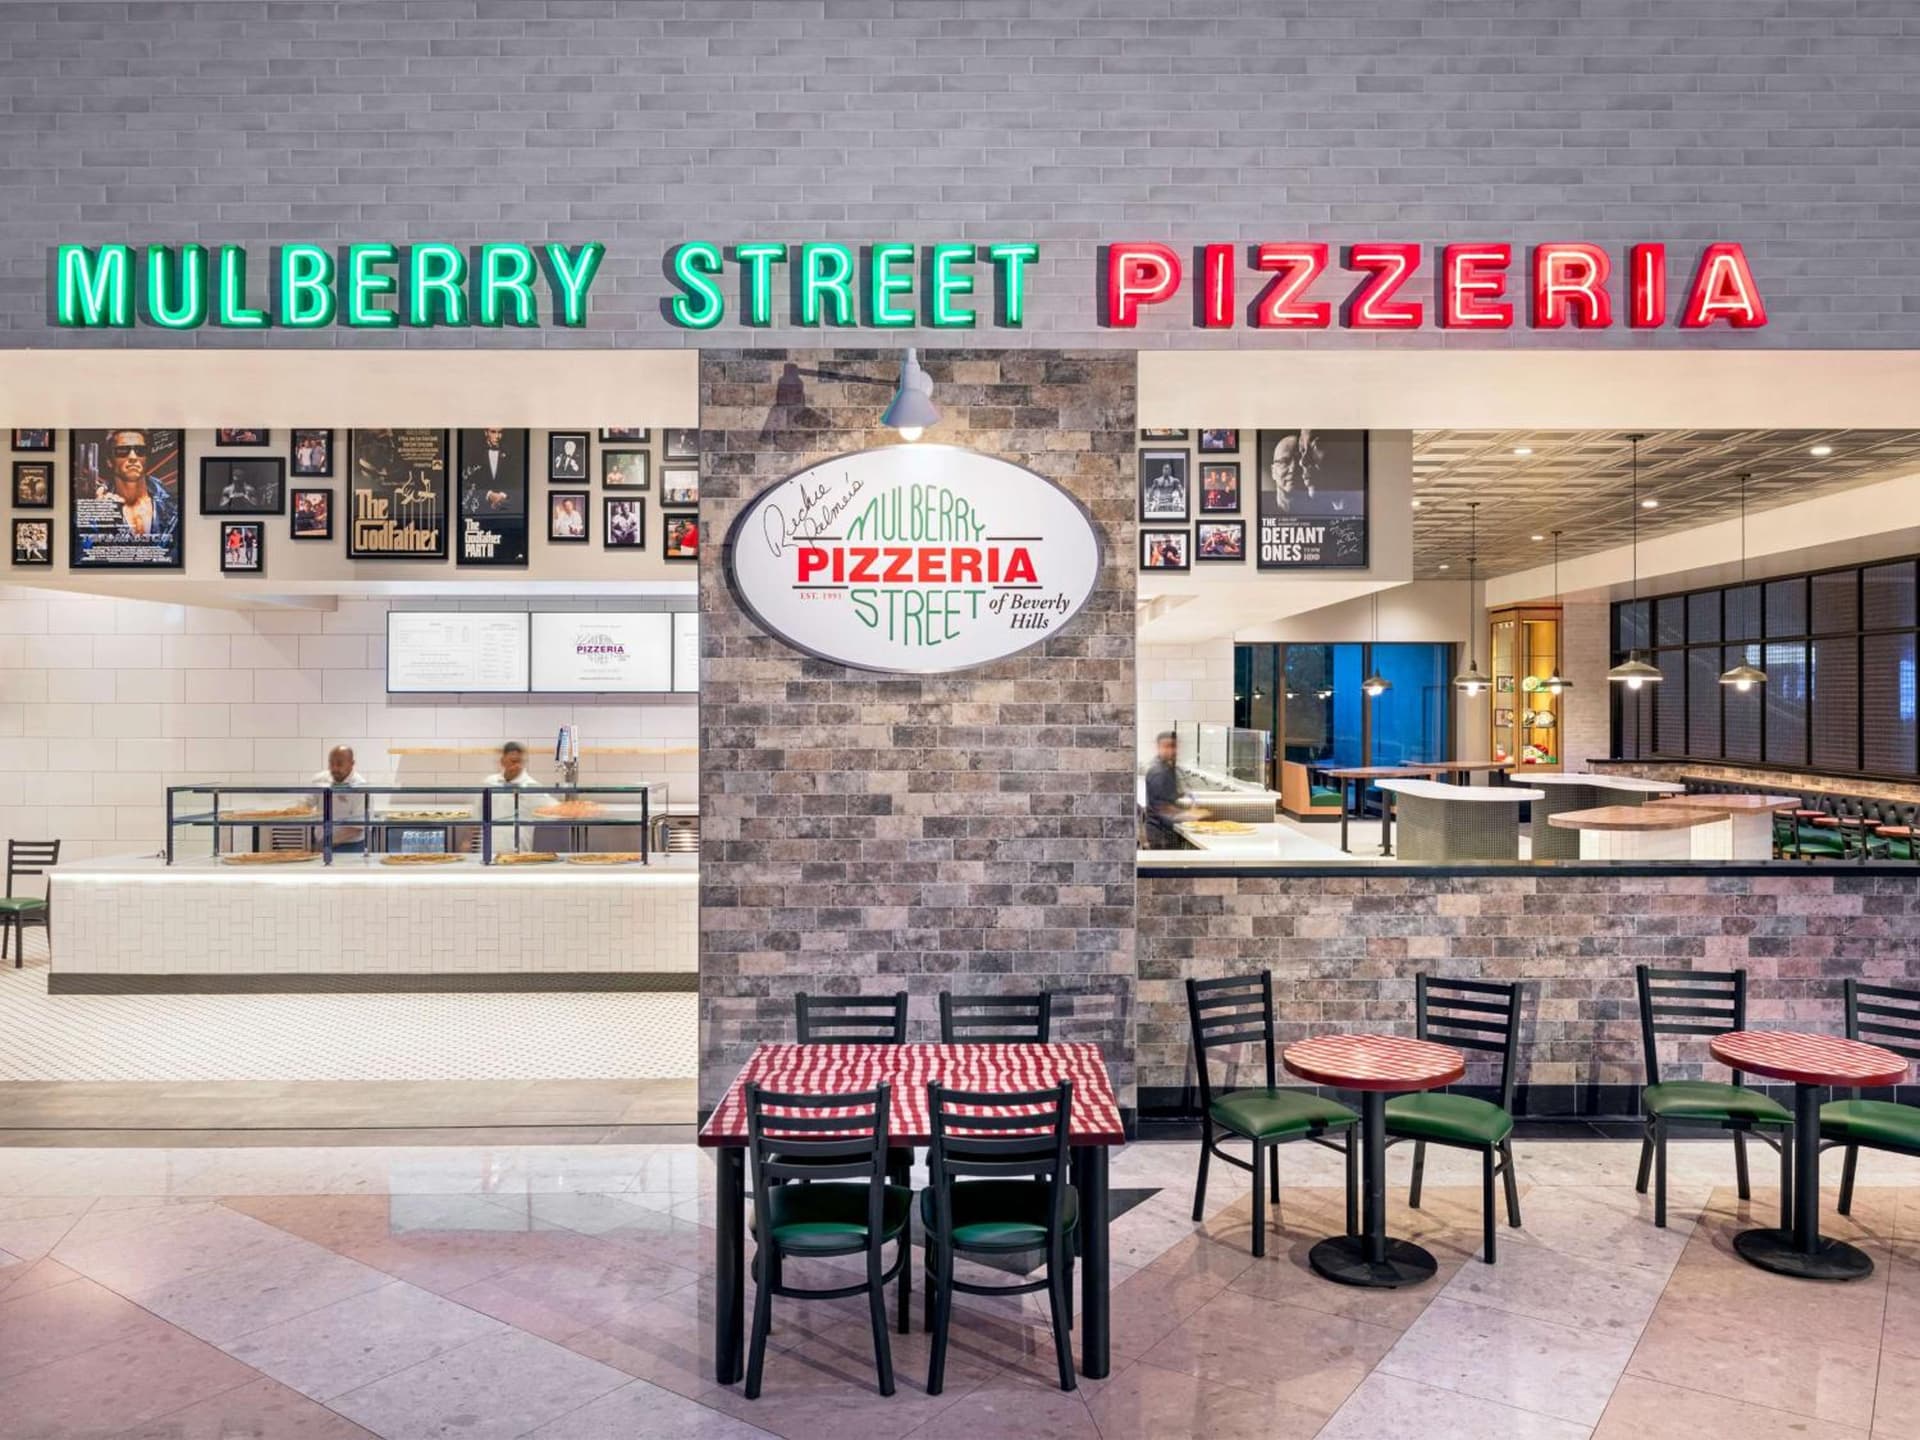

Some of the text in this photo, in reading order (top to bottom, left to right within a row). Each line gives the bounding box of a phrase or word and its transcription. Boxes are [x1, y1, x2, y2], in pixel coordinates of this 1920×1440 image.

[57, 242, 1768, 328] MULBERRY STREET PIZZERIA
[355, 489, 389, 519] The
[846, 483, 986, 543] MULBERRY
[464, 518, 480, 531] The
[1262, 518, 1276, 527] THE
[355, 520, 439, 551] Godfather
[1261, 527, 1325, 544] DEFIANT
[465, 544, 486, 558] PART
[1261, 544, 1302, 562] ONES
[797, 547, 1038, 583] PIZZERIA
[989, 592, 1070, 615] of Beverly
[850, 588, 986, 646] STREET
[1010, 613, 1049, 629] Hills
[576, 645, 625, 654] PIZZERIA
